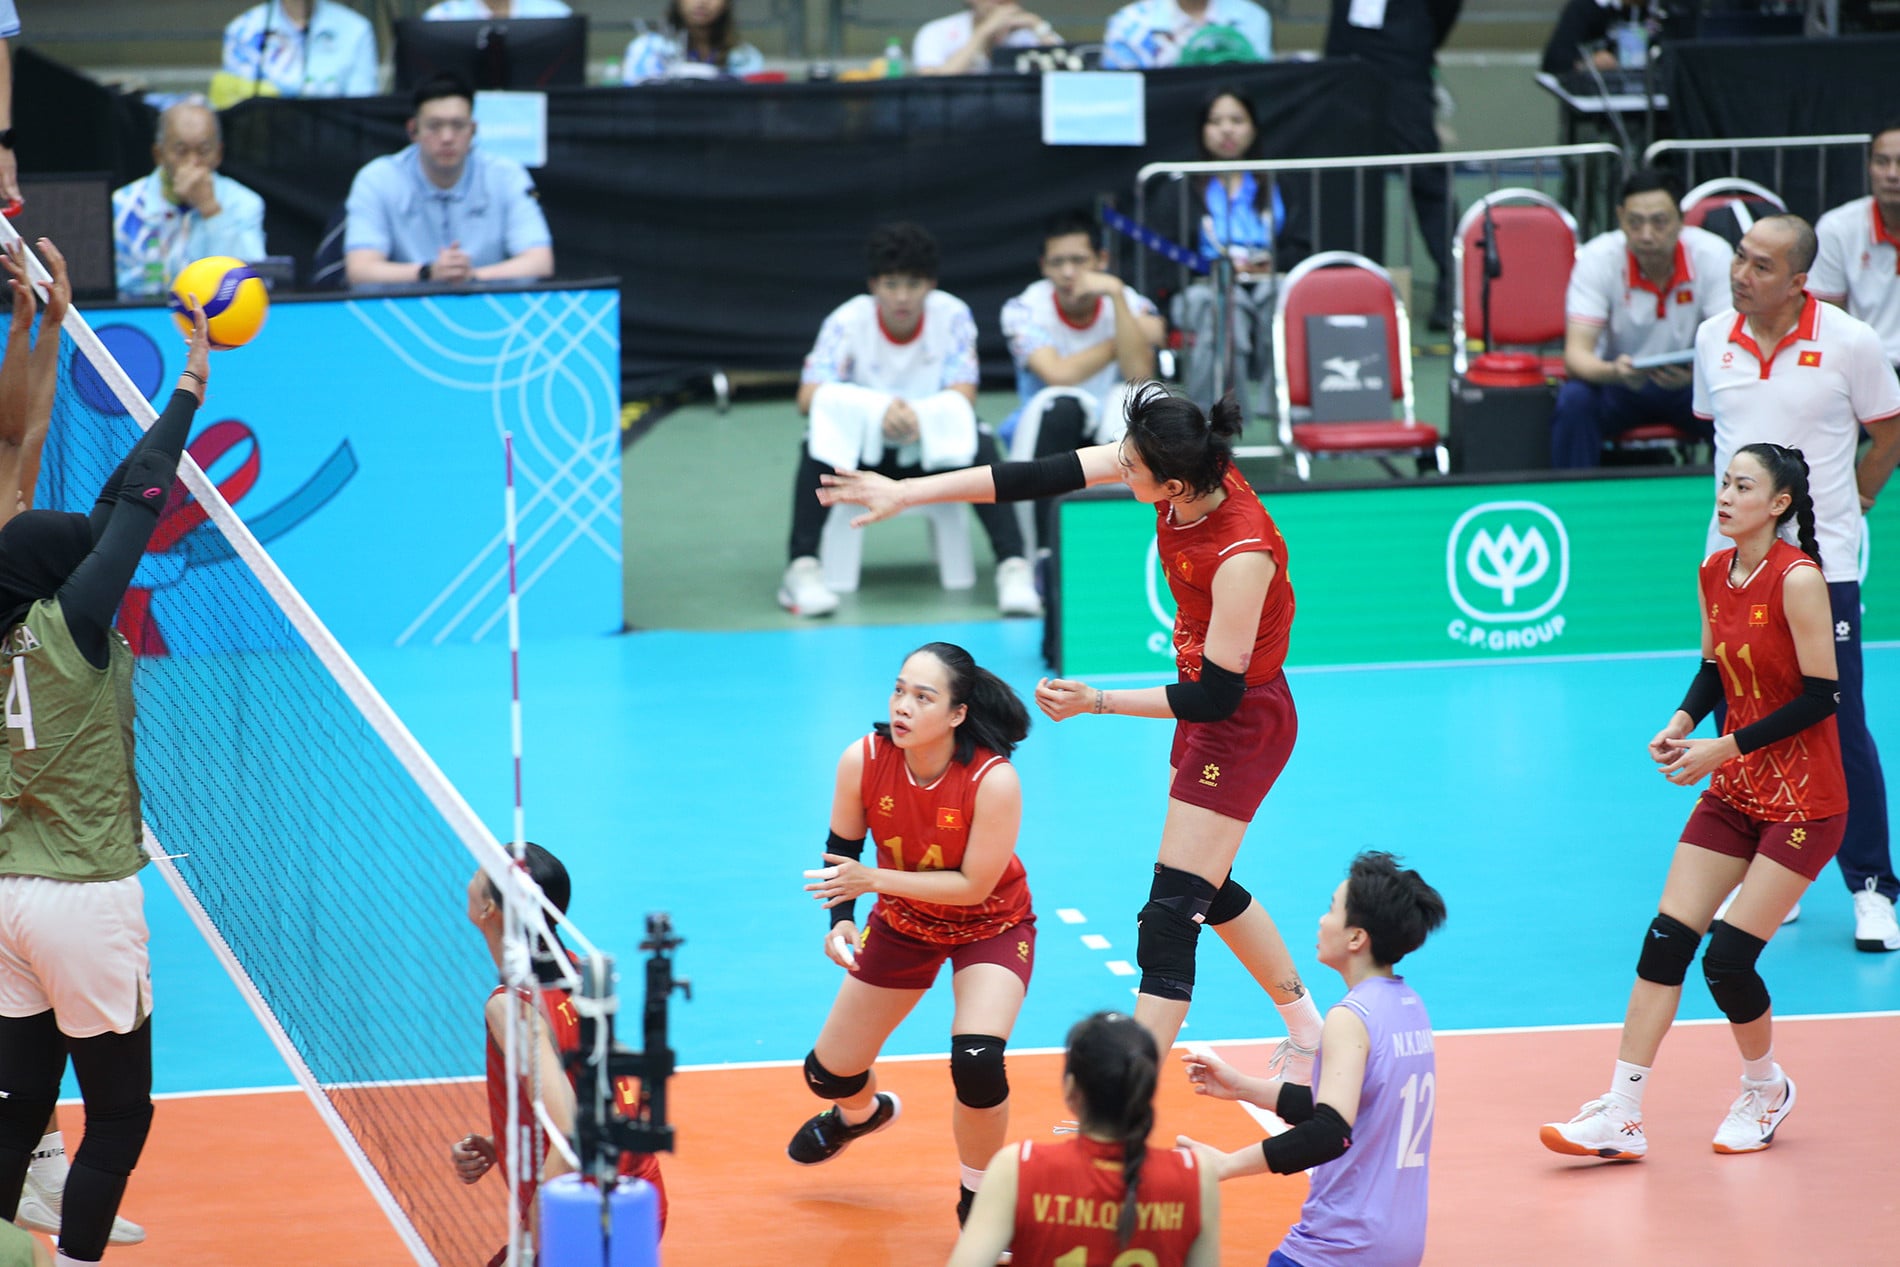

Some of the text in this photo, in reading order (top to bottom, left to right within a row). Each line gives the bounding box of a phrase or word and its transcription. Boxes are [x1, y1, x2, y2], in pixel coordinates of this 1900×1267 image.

[1715, 642, 1760, 698] 11
[883, 836, 945, 871] 14
[1397, 1072, 1436, 1169] 12
[1033, 1193, 1185, 1231] V.T.N.QYNH
